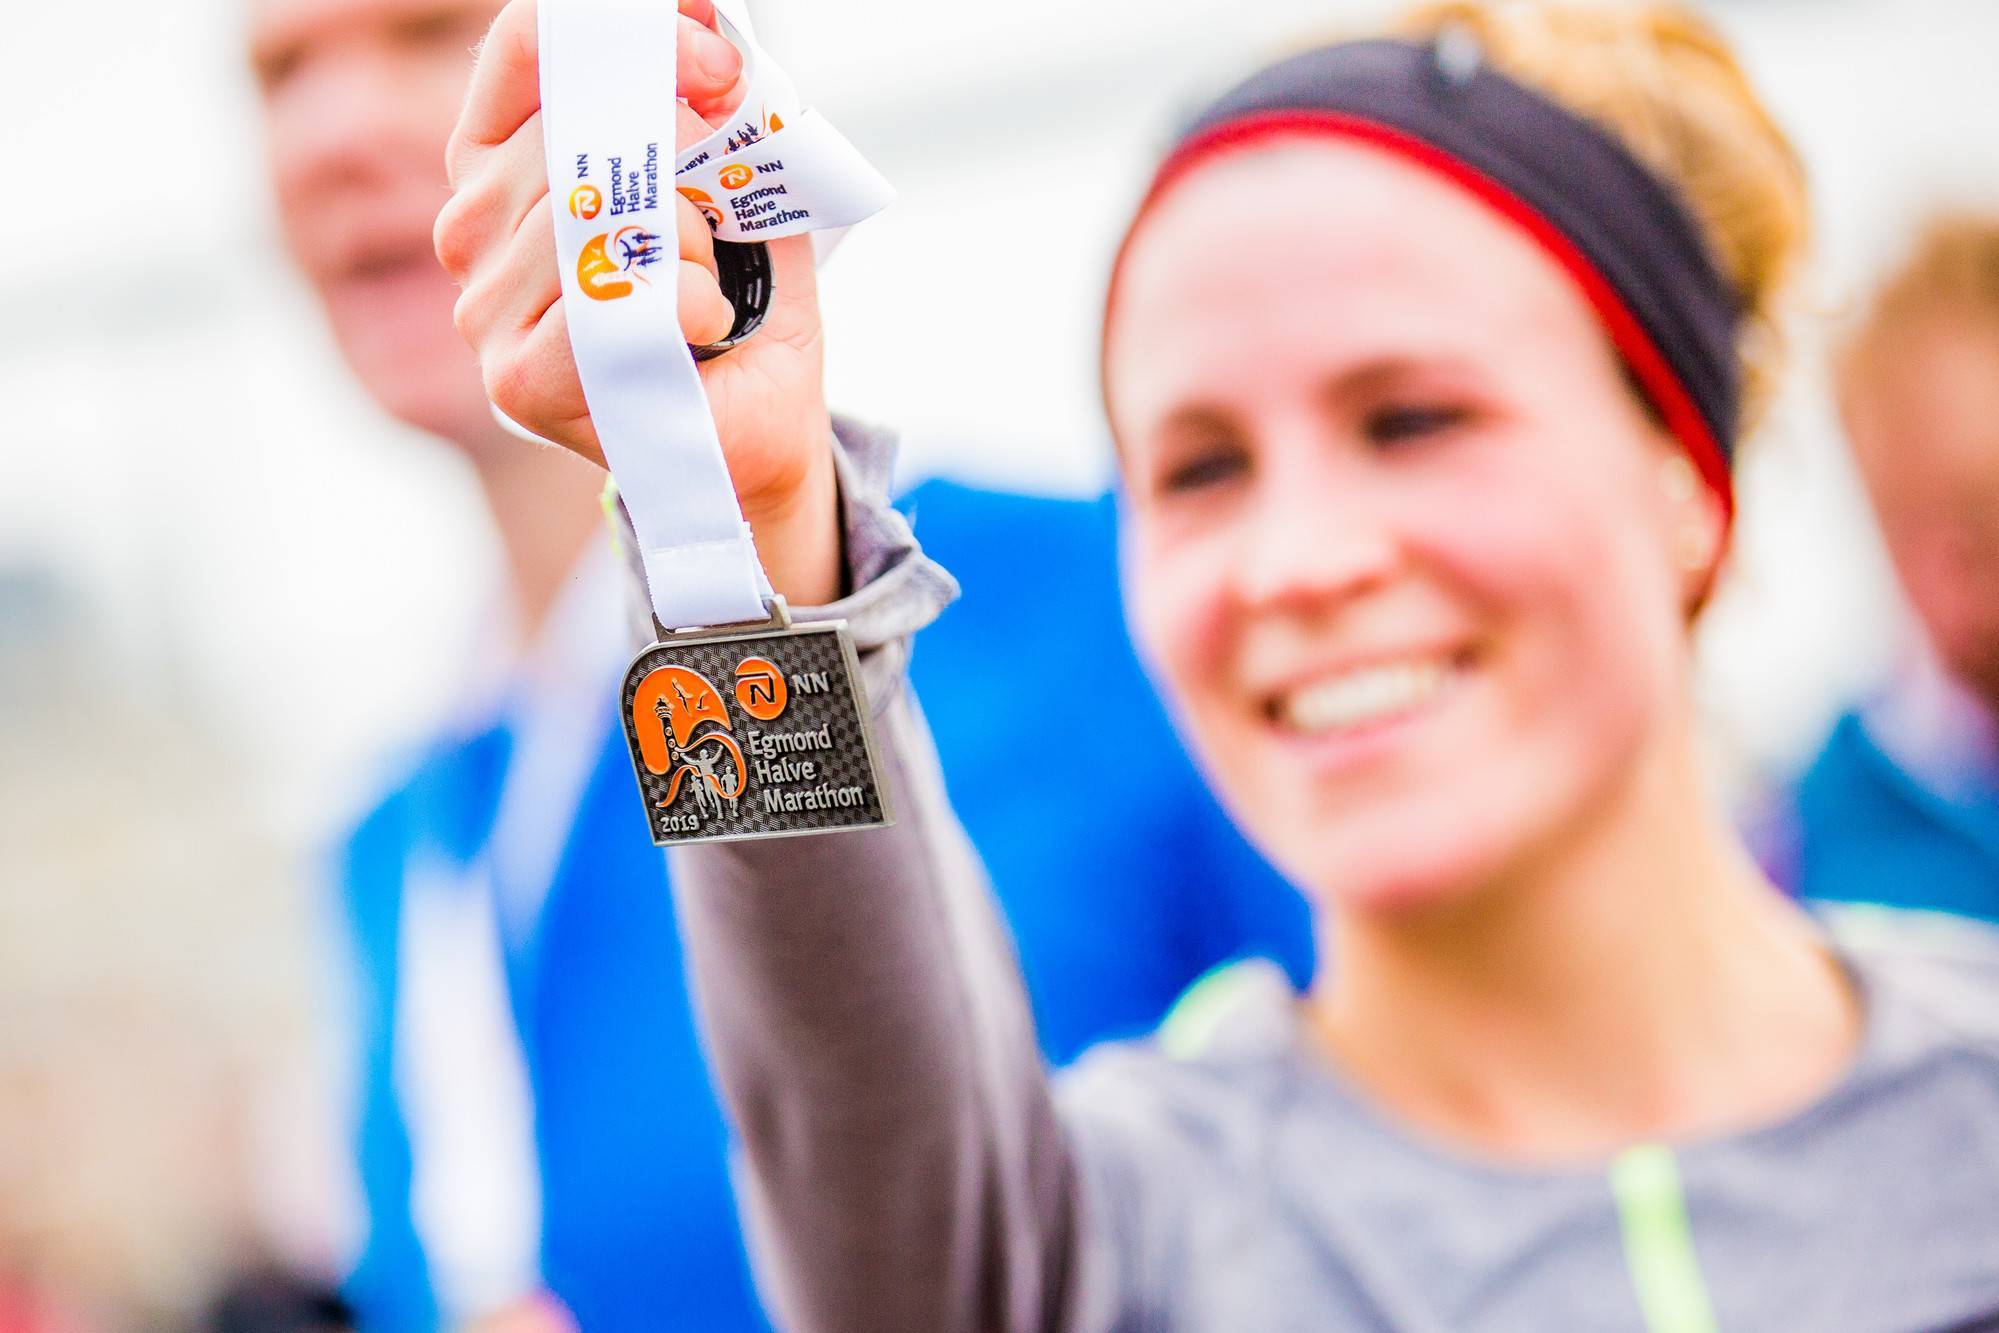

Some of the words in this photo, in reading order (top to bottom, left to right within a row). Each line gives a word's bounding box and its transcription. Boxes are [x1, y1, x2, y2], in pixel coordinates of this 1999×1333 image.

[577, 154, 589, 179] NN
[642, 142, 658, 210] Marathon
[756, 160, 785, 174] NN
[608, 157, 626, 216] Egmond
[625, 171, 640, 213] Halve
[730, 184, 788, 210] Egmond
[735, 200, 777, 221] Halve
[740, 208, 810, 232] Marathon
[792, 671, 831, 695] NN
[748, 723, 833, 760] Egmond
[755, 759, 818, 784] Halve
[763, 784, 865, 814] Marathon
[660, 814, 700, 833] 2019
